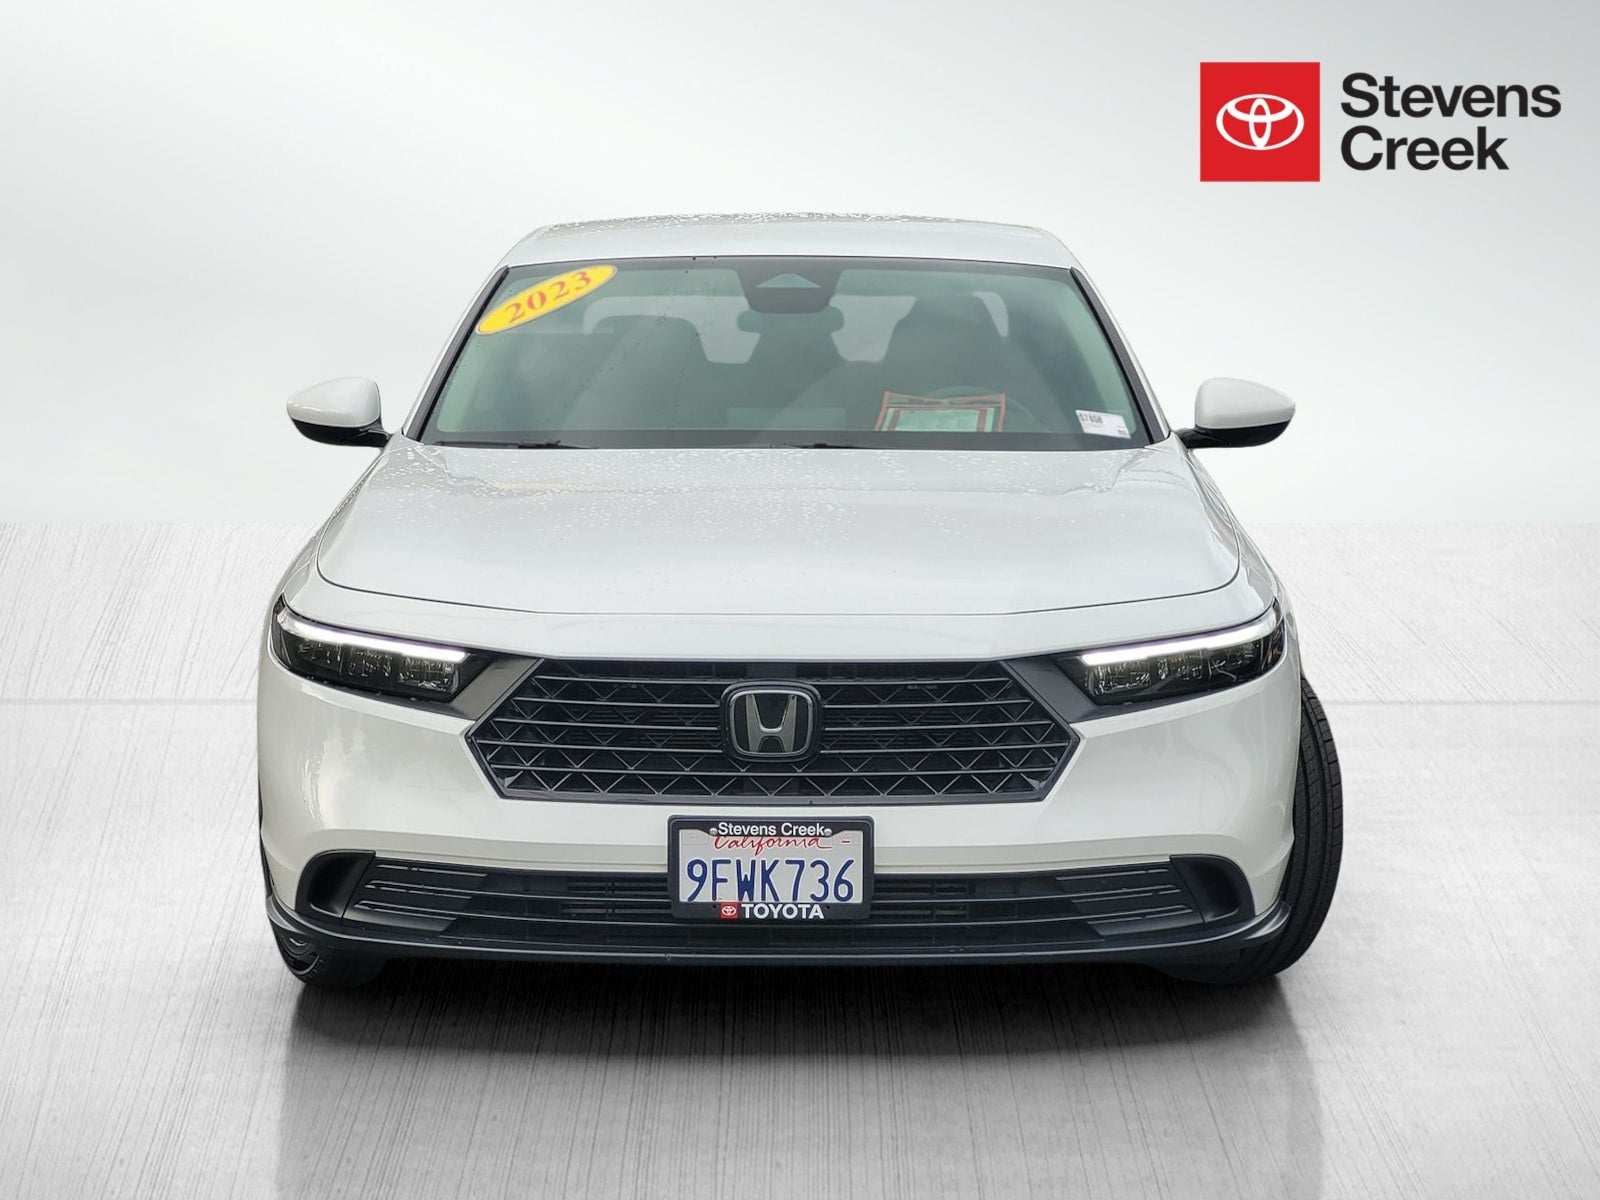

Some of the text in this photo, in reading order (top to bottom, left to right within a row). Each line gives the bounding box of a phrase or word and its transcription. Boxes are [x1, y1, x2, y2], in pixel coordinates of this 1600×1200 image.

[505, 270, 591, 323] 2023
[717, 822, 825, 836] Stevens Creek
[714, 835, 832, 856] California
[687, 859, 854, 902] 9FWK736
[741, 904, 825, 919] TOYOTA
